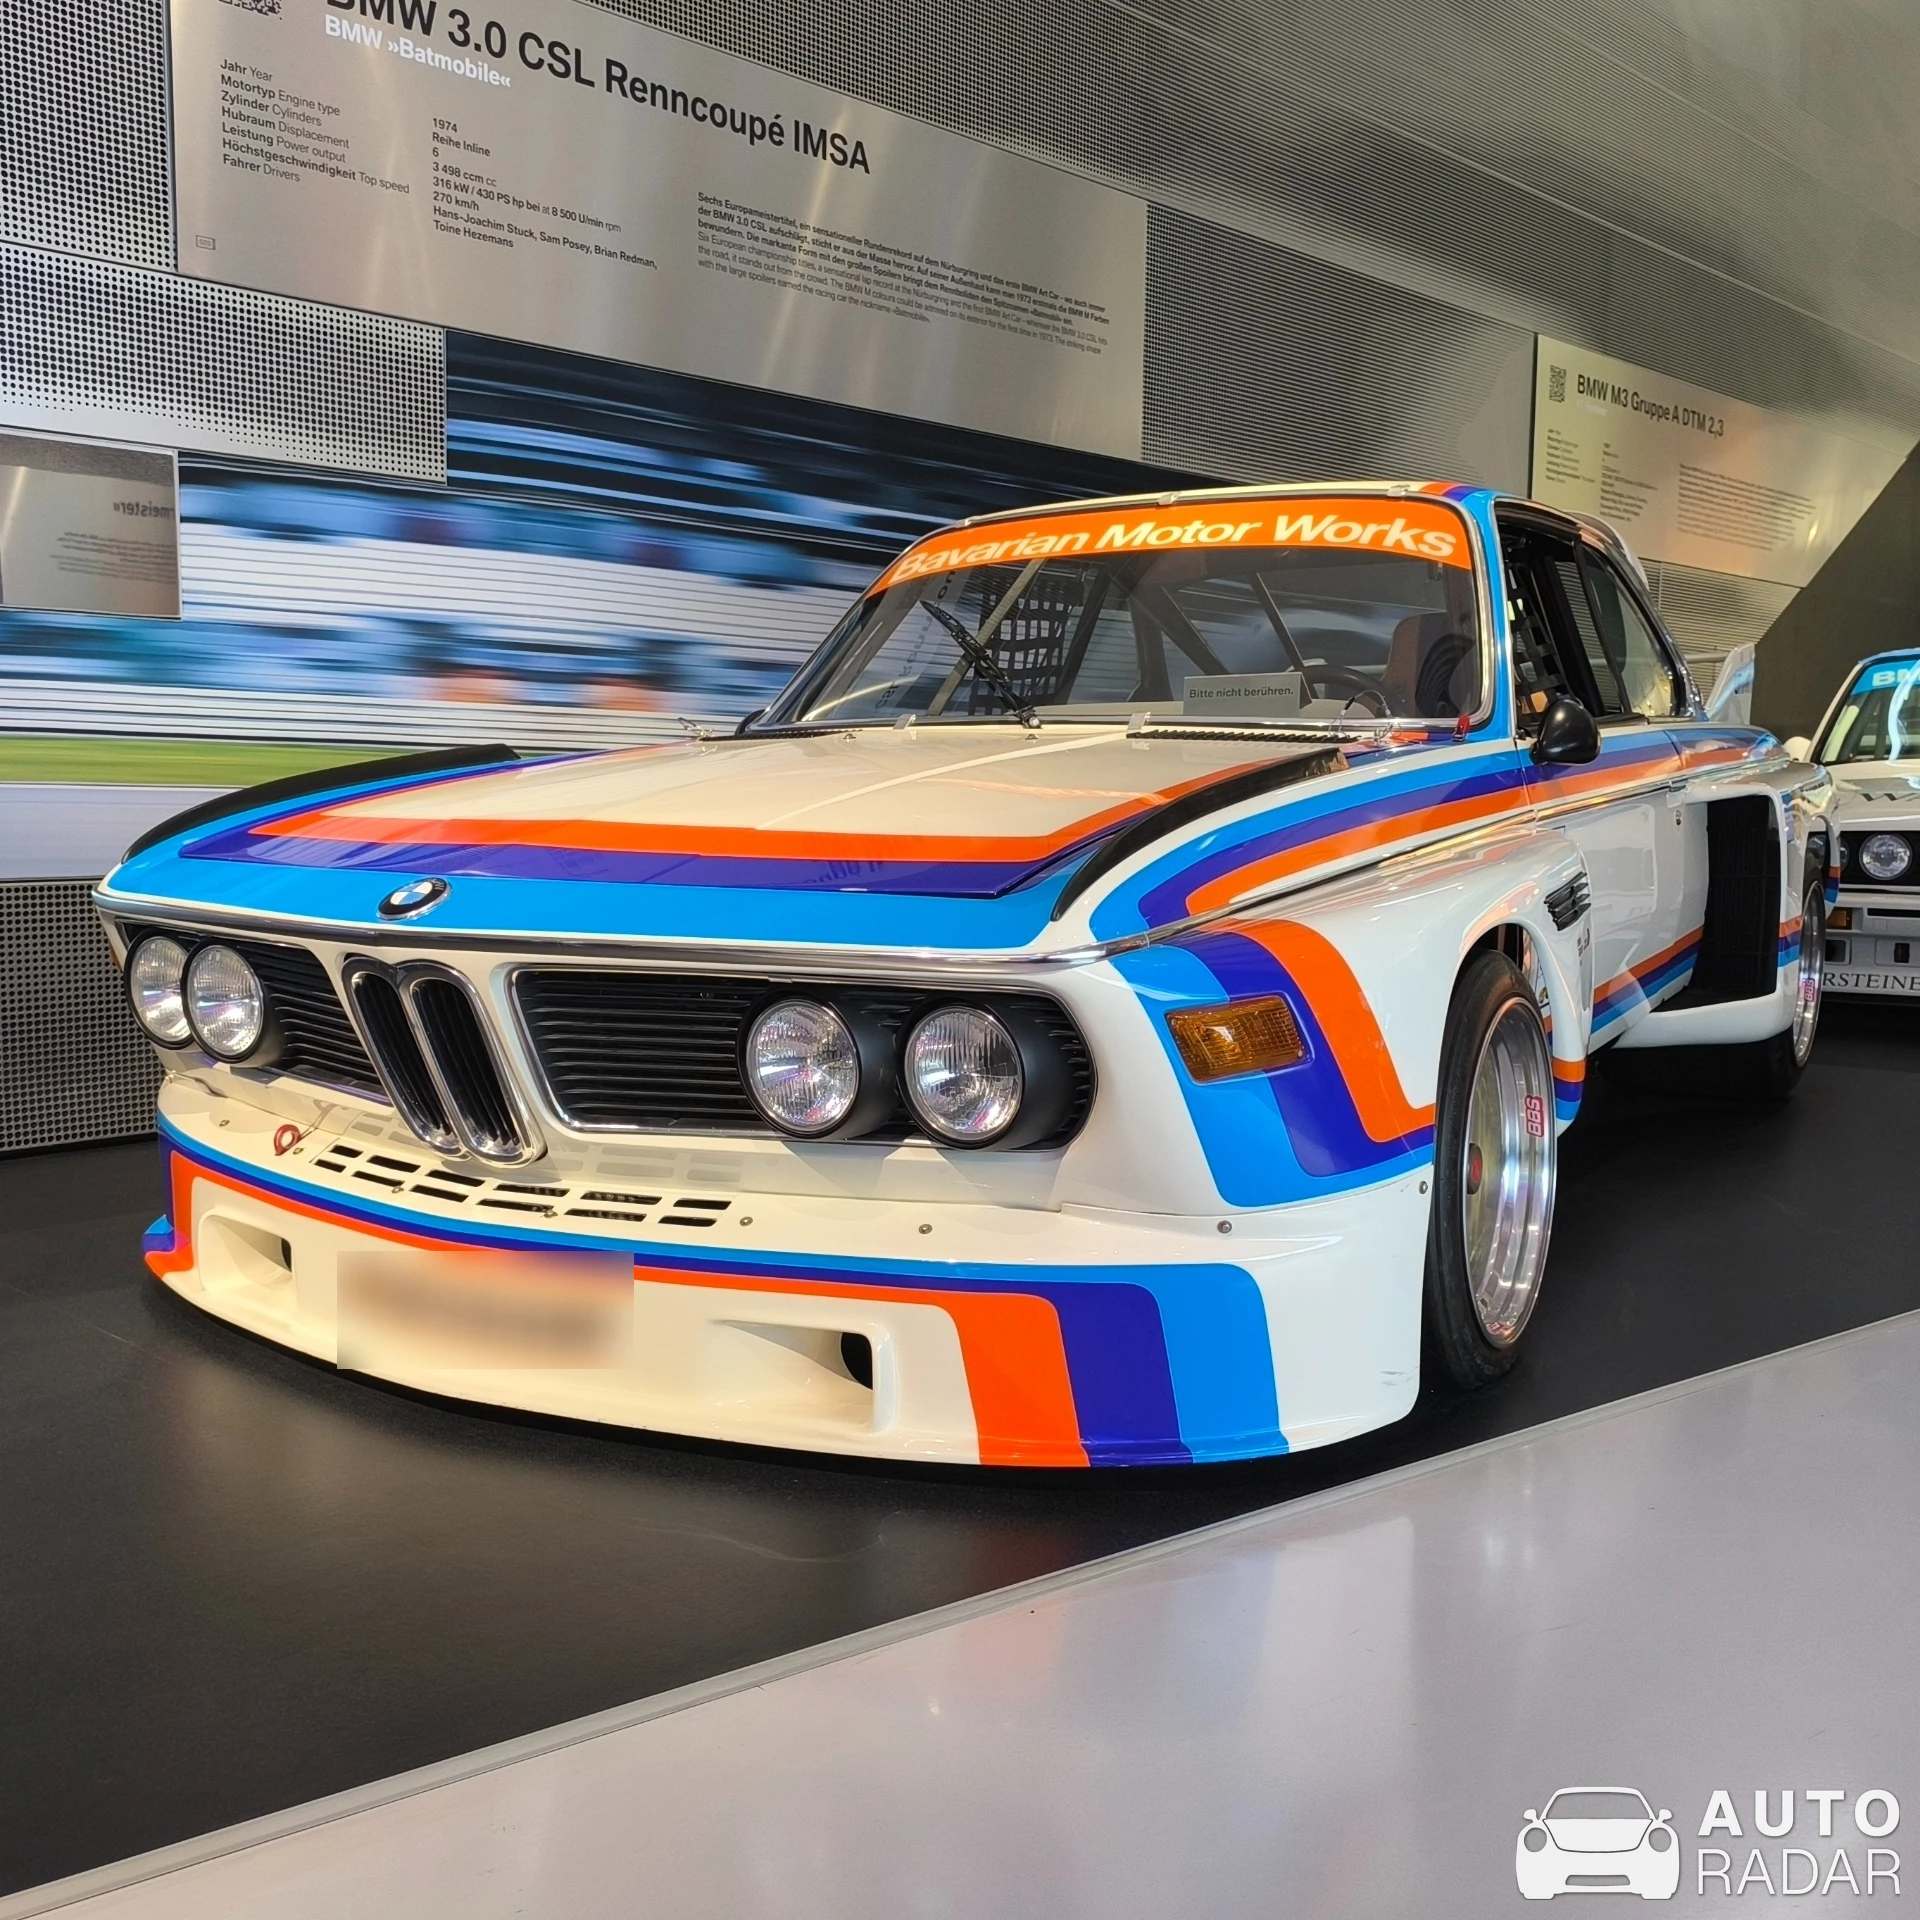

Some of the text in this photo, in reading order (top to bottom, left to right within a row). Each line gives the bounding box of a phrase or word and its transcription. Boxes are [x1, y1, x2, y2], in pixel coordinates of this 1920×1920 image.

[220, 59, 273, 81] Jahr Year
[325, 14, 512, 87] BMW »Batmobile«
[220, 74, 340, 115] Motortyp Engine type
[327, 0, 870, 175] MW 3.0 CSL Renncoupé IMSA
[220, 90, 322, 126] Zylinder Cylinders
[221, 106, 349, 148] Hubraum Displacement
[432, 118, 457, 132] 1974
[221, 122, 345, 162] Leistung Power output
[432, 132, 490, 156] Reihe Inline
[432, 146, 439, 157] 6
[222, 138, 409, 193] Höchstgeschwindigkeit Top speed
[222, 153, 300, 181] Fahrer Drivers
[432, 161, 497, 187] 3 498 ccm cc
[432, 176, 451, 189] 316
[453, 181, 469, 193] kW
[476, 188, 494, 200] 430
[496, 192, 510, 204] PS
[512, 196, 524, 209] hp
[526, 199, 540, 211] bei
[551, 206, 557, 216] 8
[559, 208, 576, 221] 500
[578, 213, 603, 227] U/min
[433, 190, 479, 210] 270 km/h
[697, 192, 722, 206] Sechs
[724, 199, 798, 228] Europameistertitel,
[799, 222, 810, 231] ein
[433, 219, 513, 247] Toine Hezemans
[433, 205, 657, 269] Hans-Joachim Stuck, Sam Posey, Brian Redman,
[697, 205, 711, 216] der
[712, 209, 734, 222] BMW
[736, 215, 748, 226] 3.0
[750, 219, 766, 232] CSL
[768, 226, 809, 244] aufschlägt,
[697, 218, 744, 238] bewundern.
[746, 231, 759, 242] Die
[761, 237, 795, 252] markante
[798, 245, 817, 258] Form
[1577, 374, 1609, 402] BMW
[1611, 384, 1629, 408] M3
[1631, 392, 1671, 422] Gruppe
[1672, 405, 1680, 424] A
[1682, 408, 1706, 432] DTM
[889, 513, 1457, 584] Bavarian Motor Works
[1189, 686, 1294, 698] Bitte nicht berühren.
[1525, 1096, 1543, 1137] BBS
